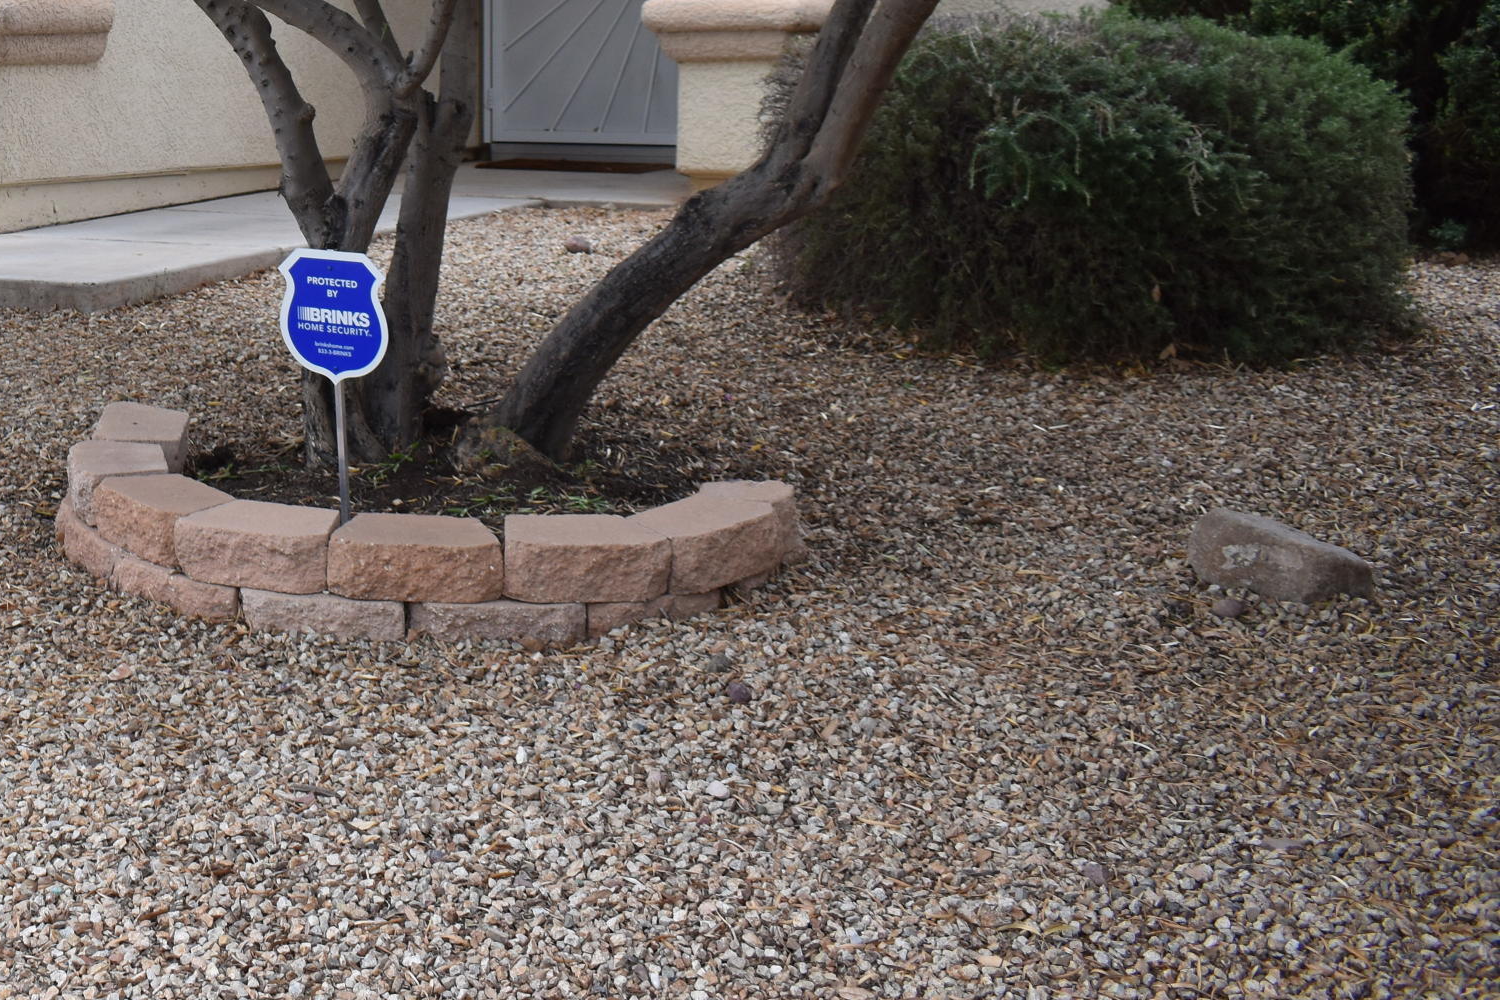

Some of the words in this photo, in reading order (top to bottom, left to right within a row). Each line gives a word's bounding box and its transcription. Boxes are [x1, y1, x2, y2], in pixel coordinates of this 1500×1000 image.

[307, 276, 358, 289] PROTECTED
[326, 289, 338, 298] BY
[306, 307, 370, 327] BRINKS
[297, 322, 324, 332] HOME
[326, 325, 370, 337] SECURITY
